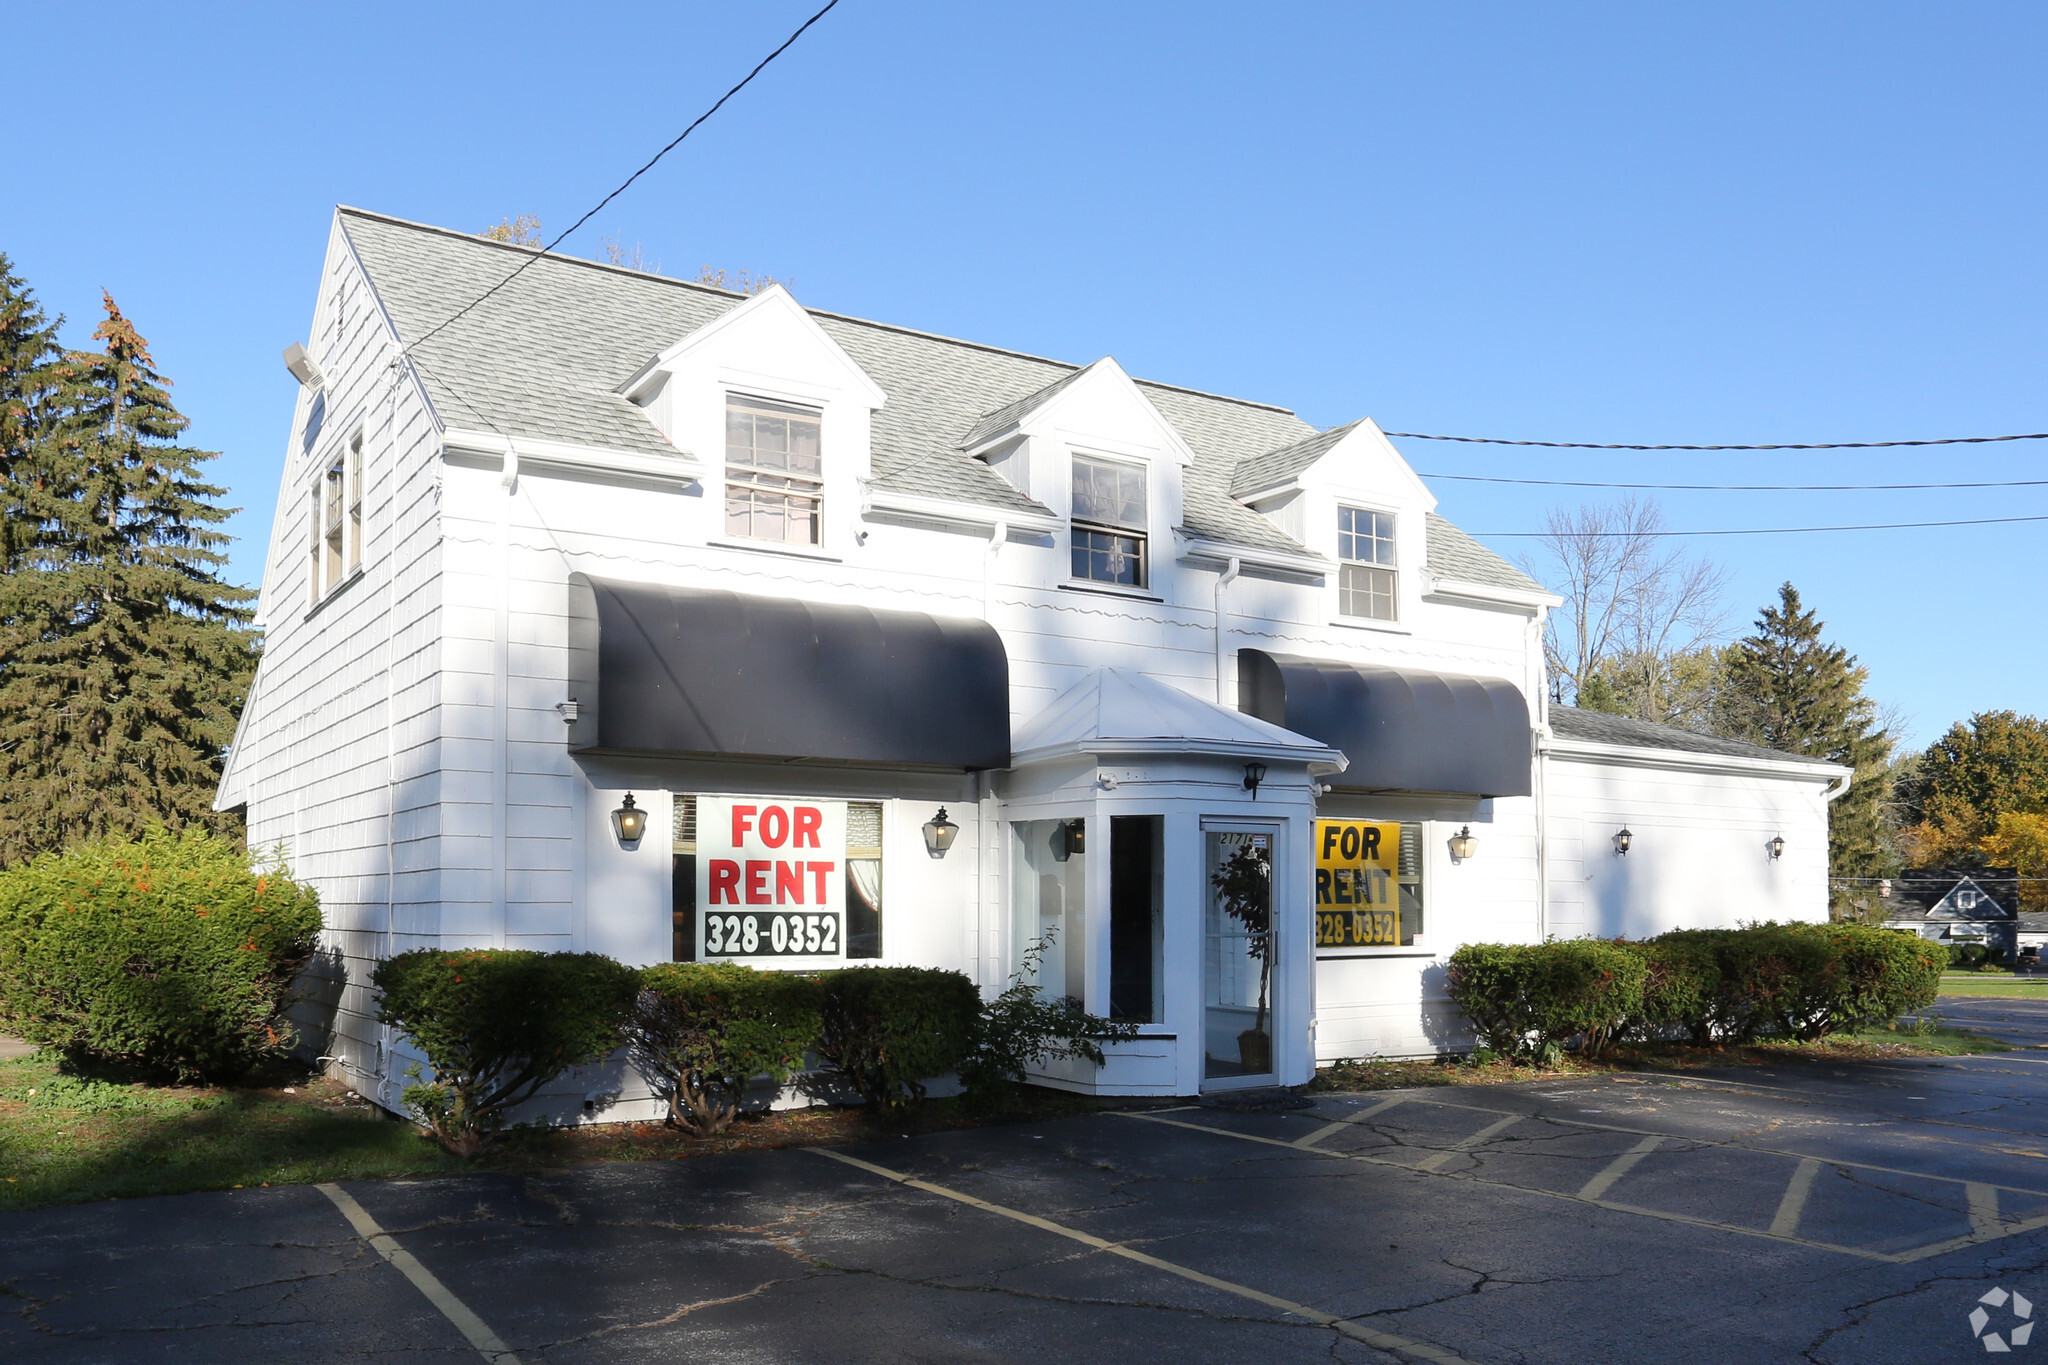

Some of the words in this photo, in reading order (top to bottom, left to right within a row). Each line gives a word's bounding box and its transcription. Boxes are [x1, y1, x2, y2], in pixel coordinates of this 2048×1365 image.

[732, 805, 822, 848] FOR
[1220, 833, 1248, 845] 2171
[1323, 826, 1381, 860] FOR
[709, 860, 835, 905] RENT
[1316, 868, 1391, 904] RENT
[706, 915, 836, 953] 328-0352
